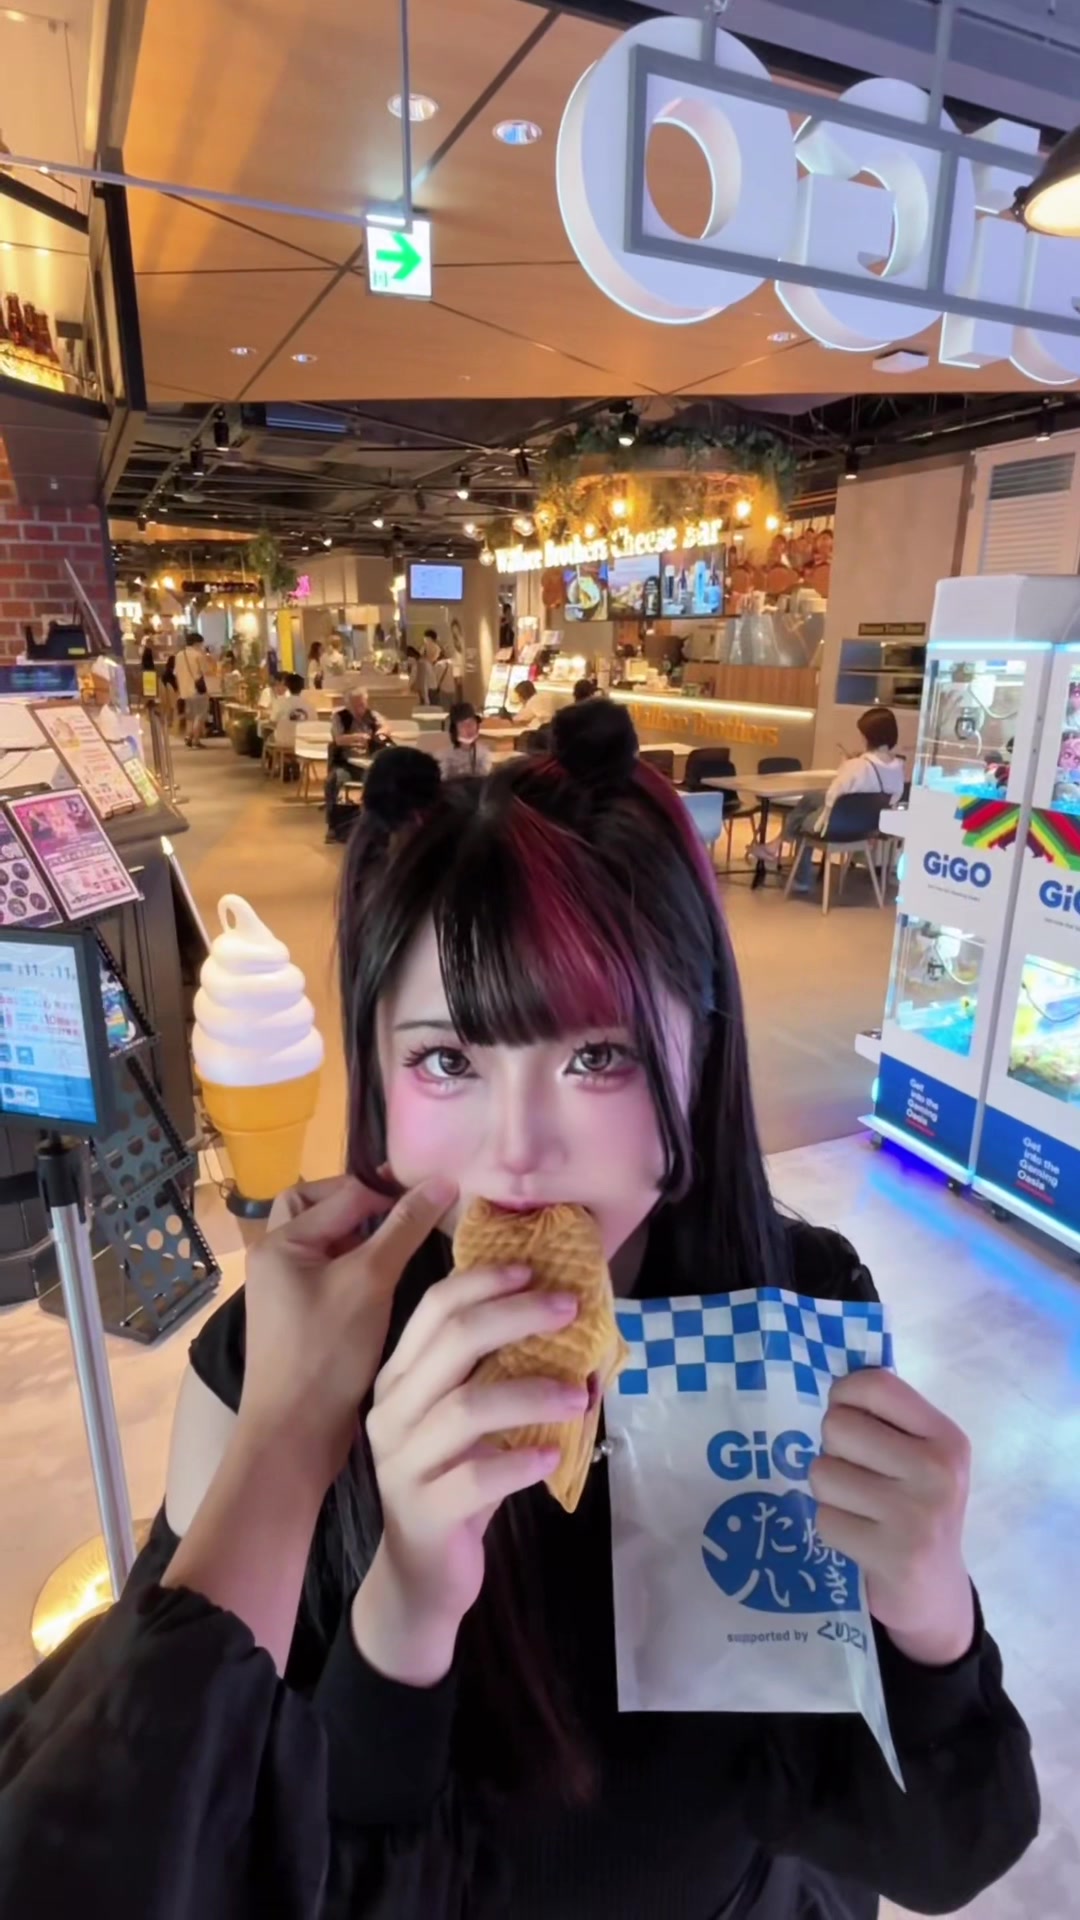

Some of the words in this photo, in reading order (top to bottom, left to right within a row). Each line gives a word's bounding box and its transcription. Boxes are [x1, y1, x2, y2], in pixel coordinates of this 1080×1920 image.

[610, 526, 678, 558] Cheese
[682, 518, 723, 549] Bar
[923, 850, 992, 888] GiGO
[1039, 880, 1080, 917] Gi
[909, 1078, 925, 1093] Get
[907, 1098, 938, 1123] Gaming
[1022, 1136, 1042, 1153] Get
[1019, 1159, 1059, 1189] Gaming
[1024, 1148, 1043, 1166] into
[1043, 1160, 1060, 1175] the
[1017, 1169, 1045, 1191] Oasis
[706, 1430, 824, 1481] GiG
[726, 1629, 790, 1644] supported
[794, 1629, 809, 1643] by
